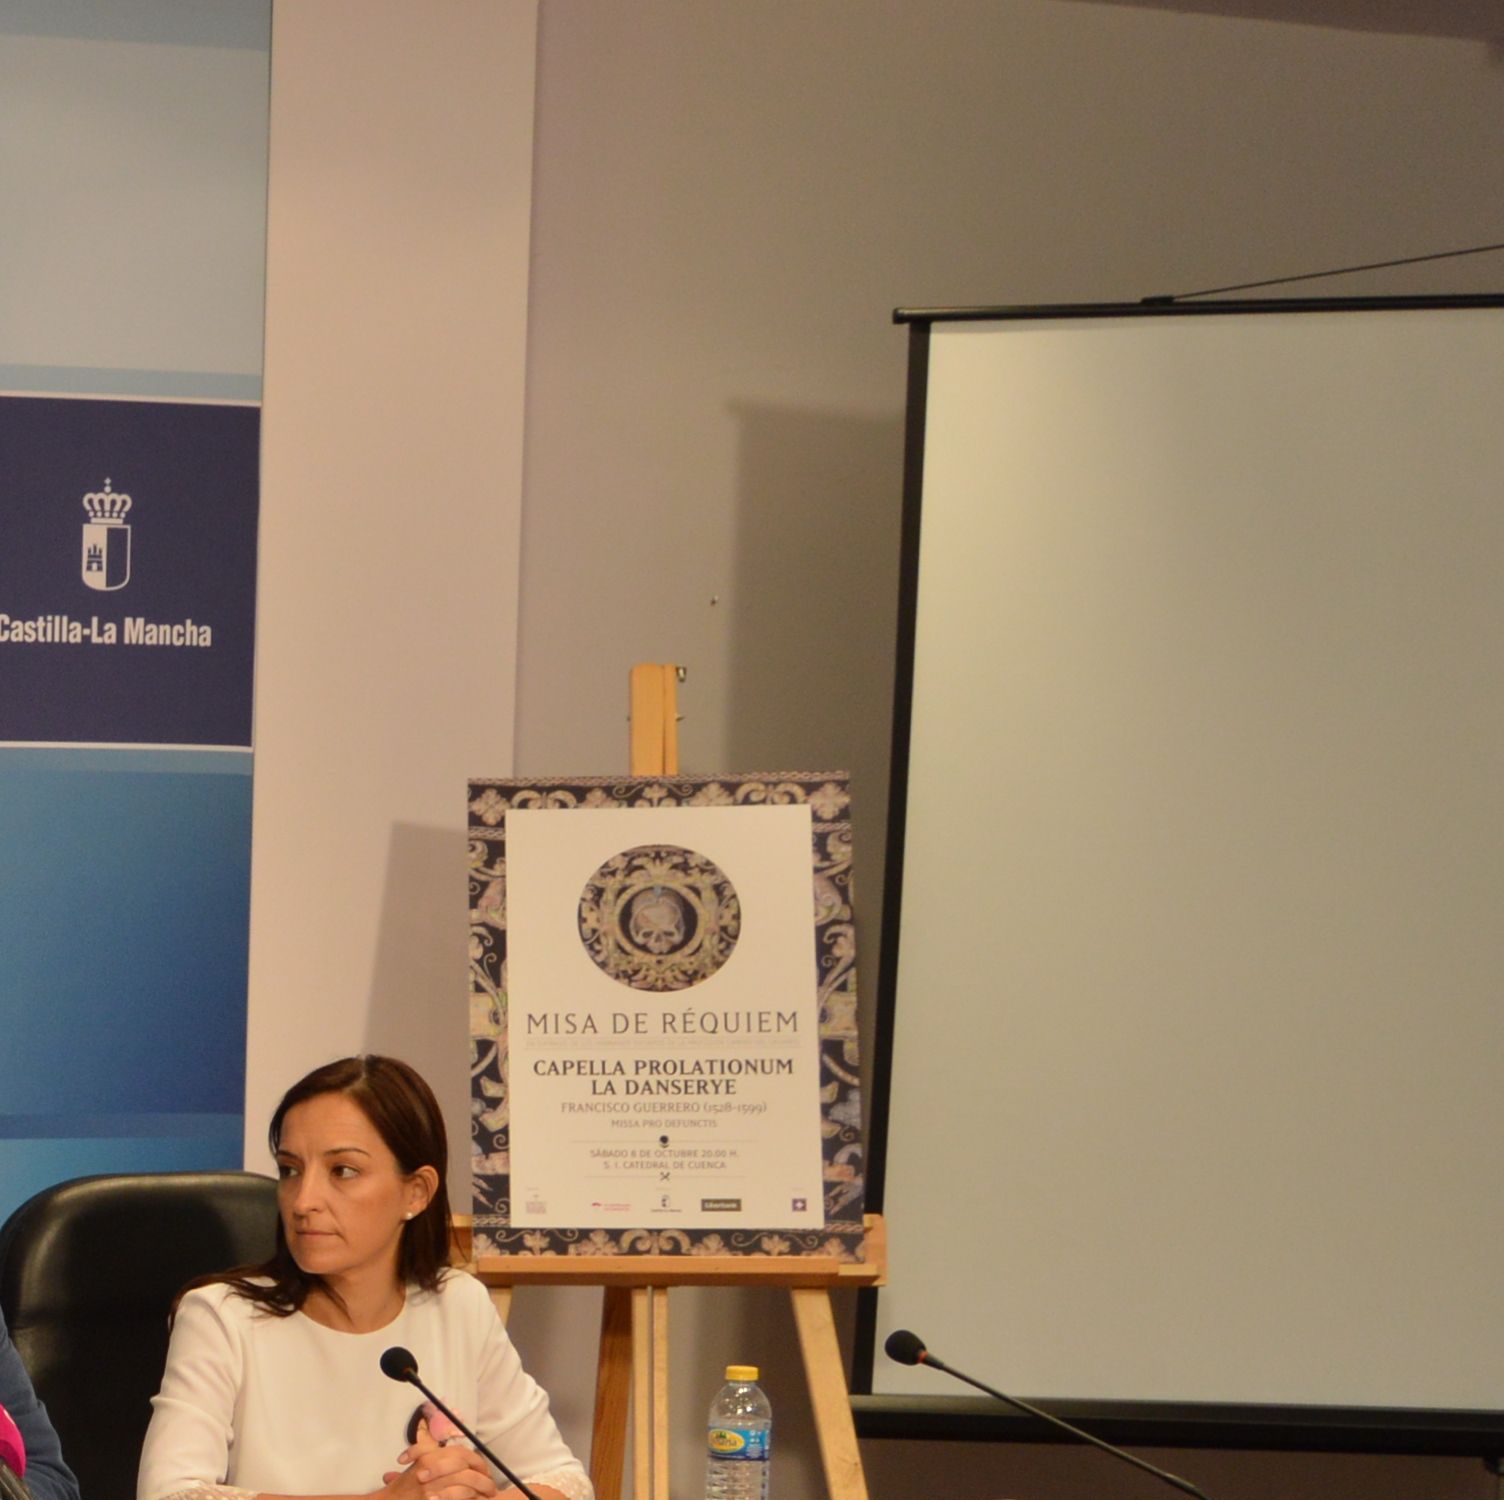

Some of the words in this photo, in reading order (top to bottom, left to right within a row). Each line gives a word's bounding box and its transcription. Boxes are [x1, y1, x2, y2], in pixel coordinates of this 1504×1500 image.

[123, 616, 212, 647] Mancha
[526, 1012, 599, 1035] MISA
[612, 1012, 649, 1034] DE
[661, 1007, 799, 1035] RÉQUIEM
[533, 1058, 626, 1077] CAPELLA
[633, 1056, 794, 1077] PROLATIONUM
[591, 1079, 617, 1096] LA
[624, 1078, 737, 1096] DANSERYE
[560, 1101, 630, 1114] FRANCISCO
[632, 1101, 701, 1113] GUERRERO
